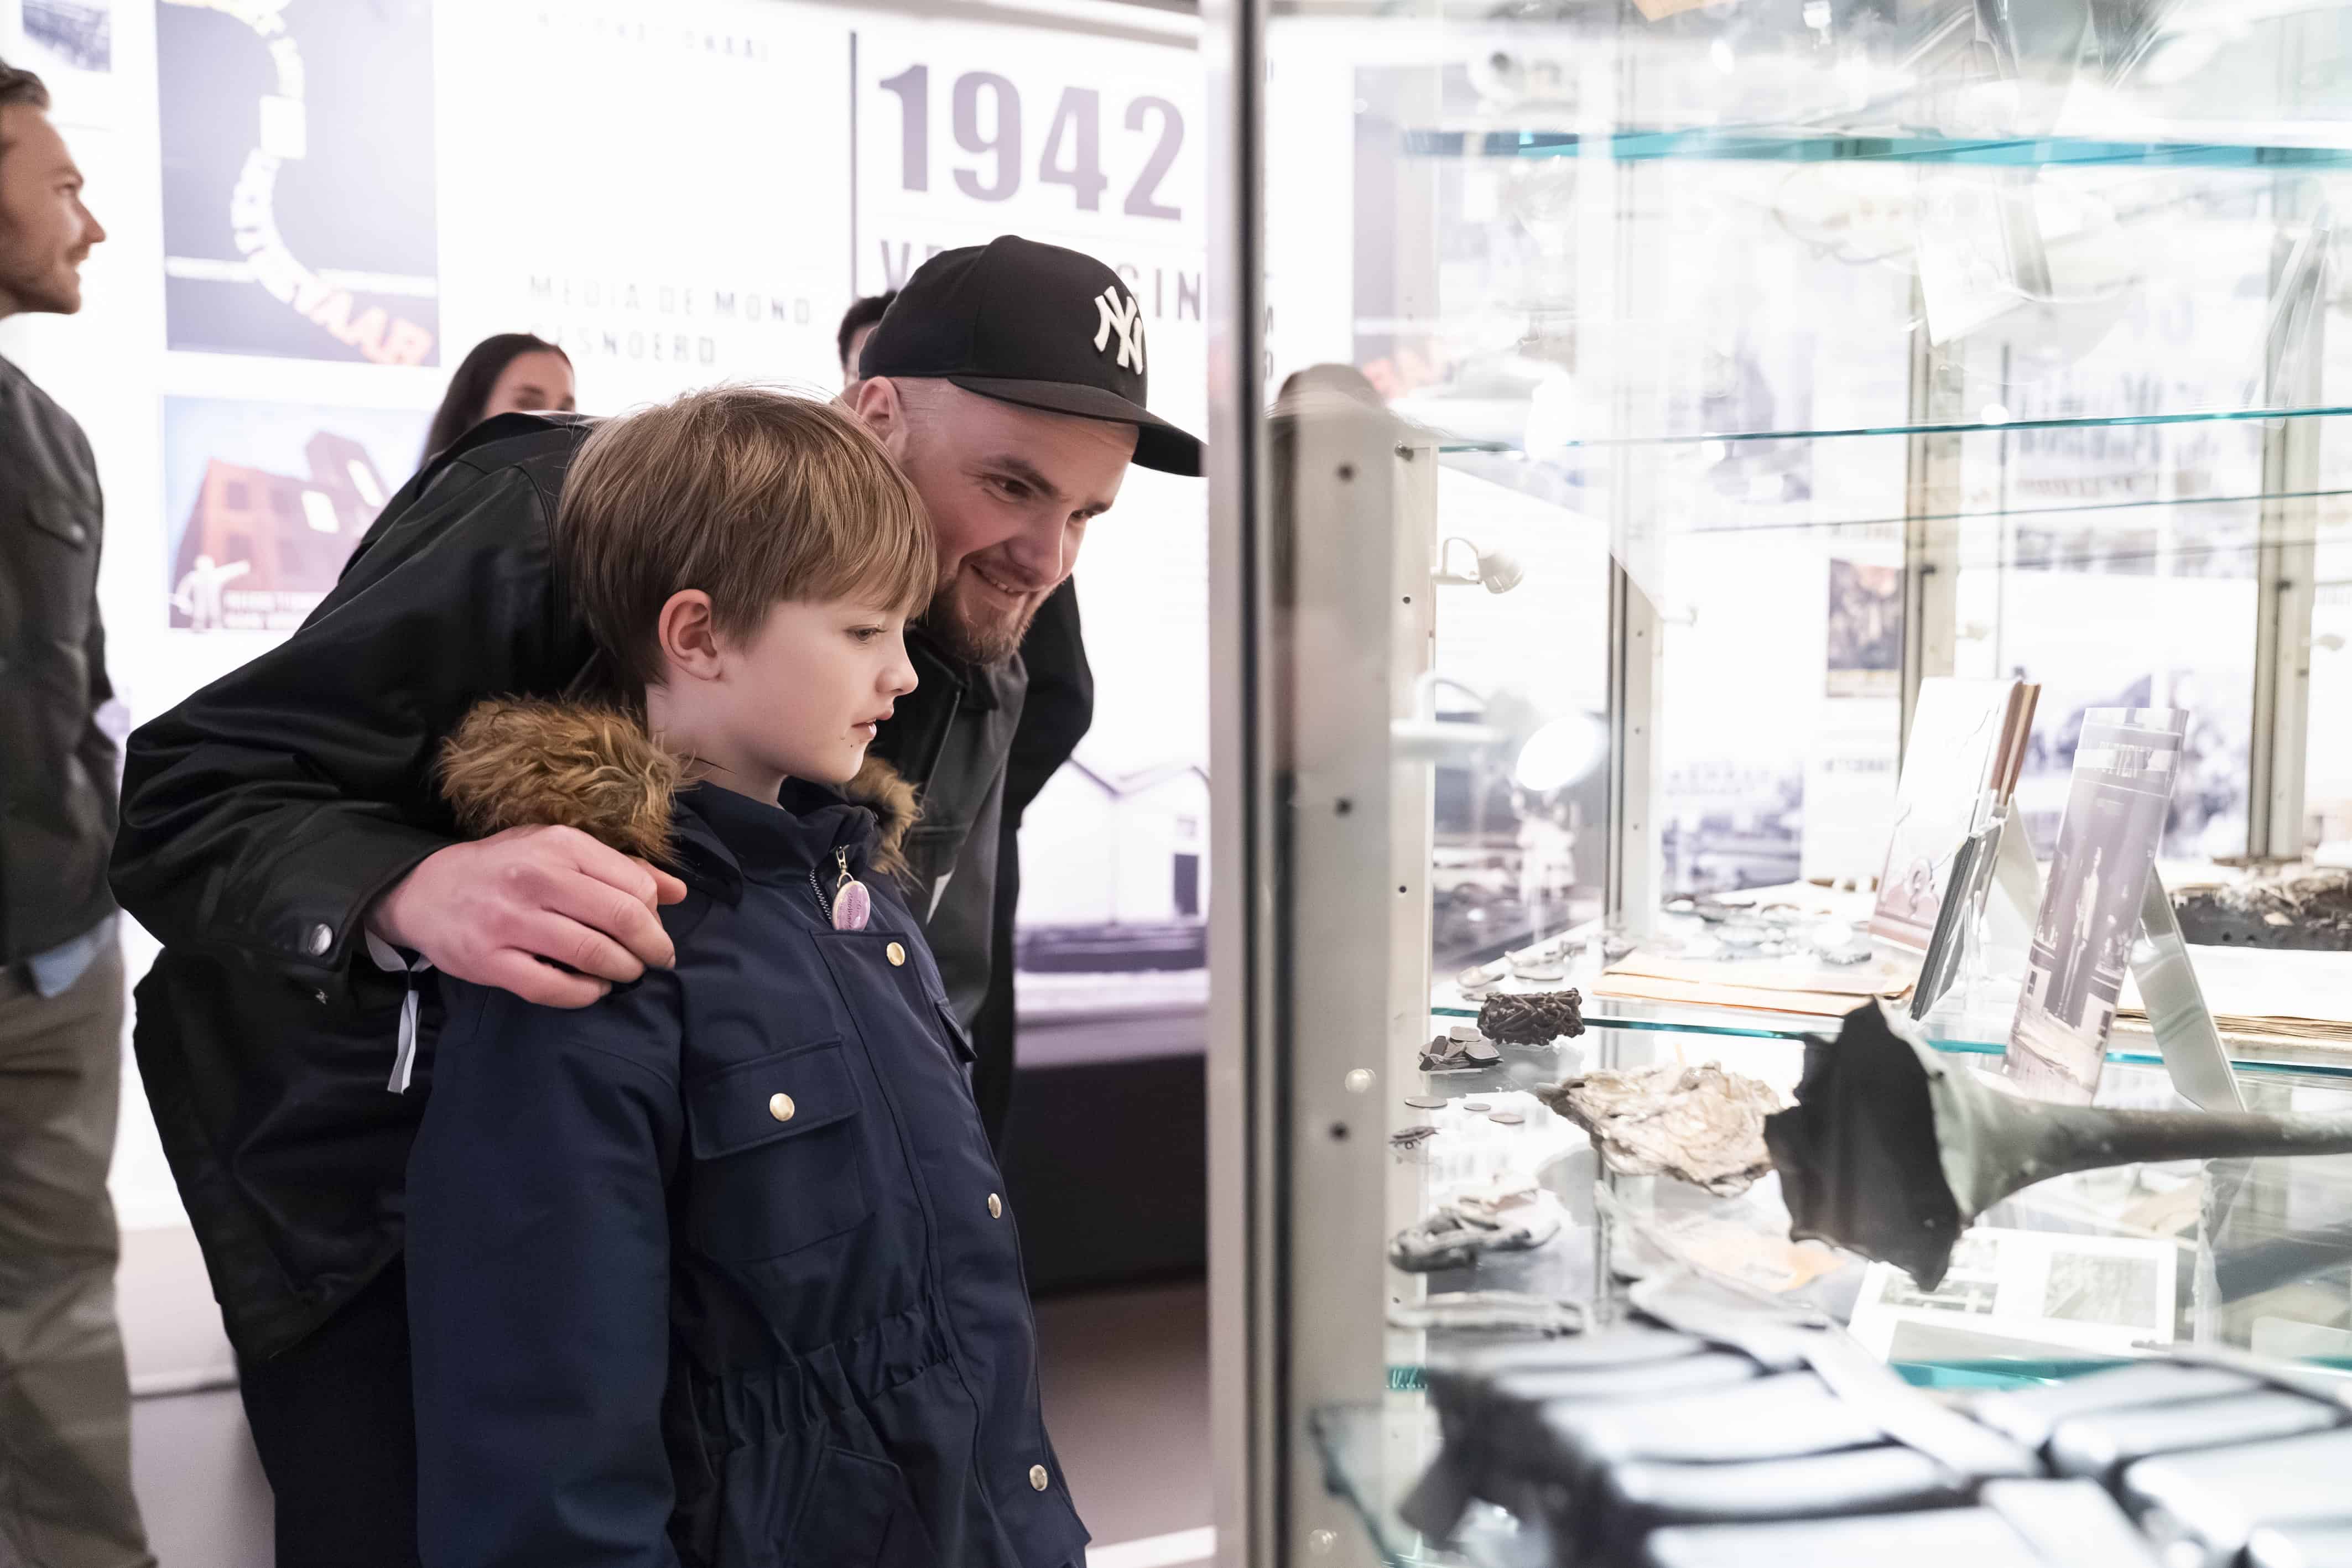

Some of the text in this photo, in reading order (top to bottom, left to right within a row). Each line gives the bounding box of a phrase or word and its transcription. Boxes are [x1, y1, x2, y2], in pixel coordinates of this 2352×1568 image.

[879, 64, 1185, 221] 1942
[529, 274, 641, 311] MEDIA
[658, 285, 694, 315] DE
[1094, 285, 1143, 375] NY
